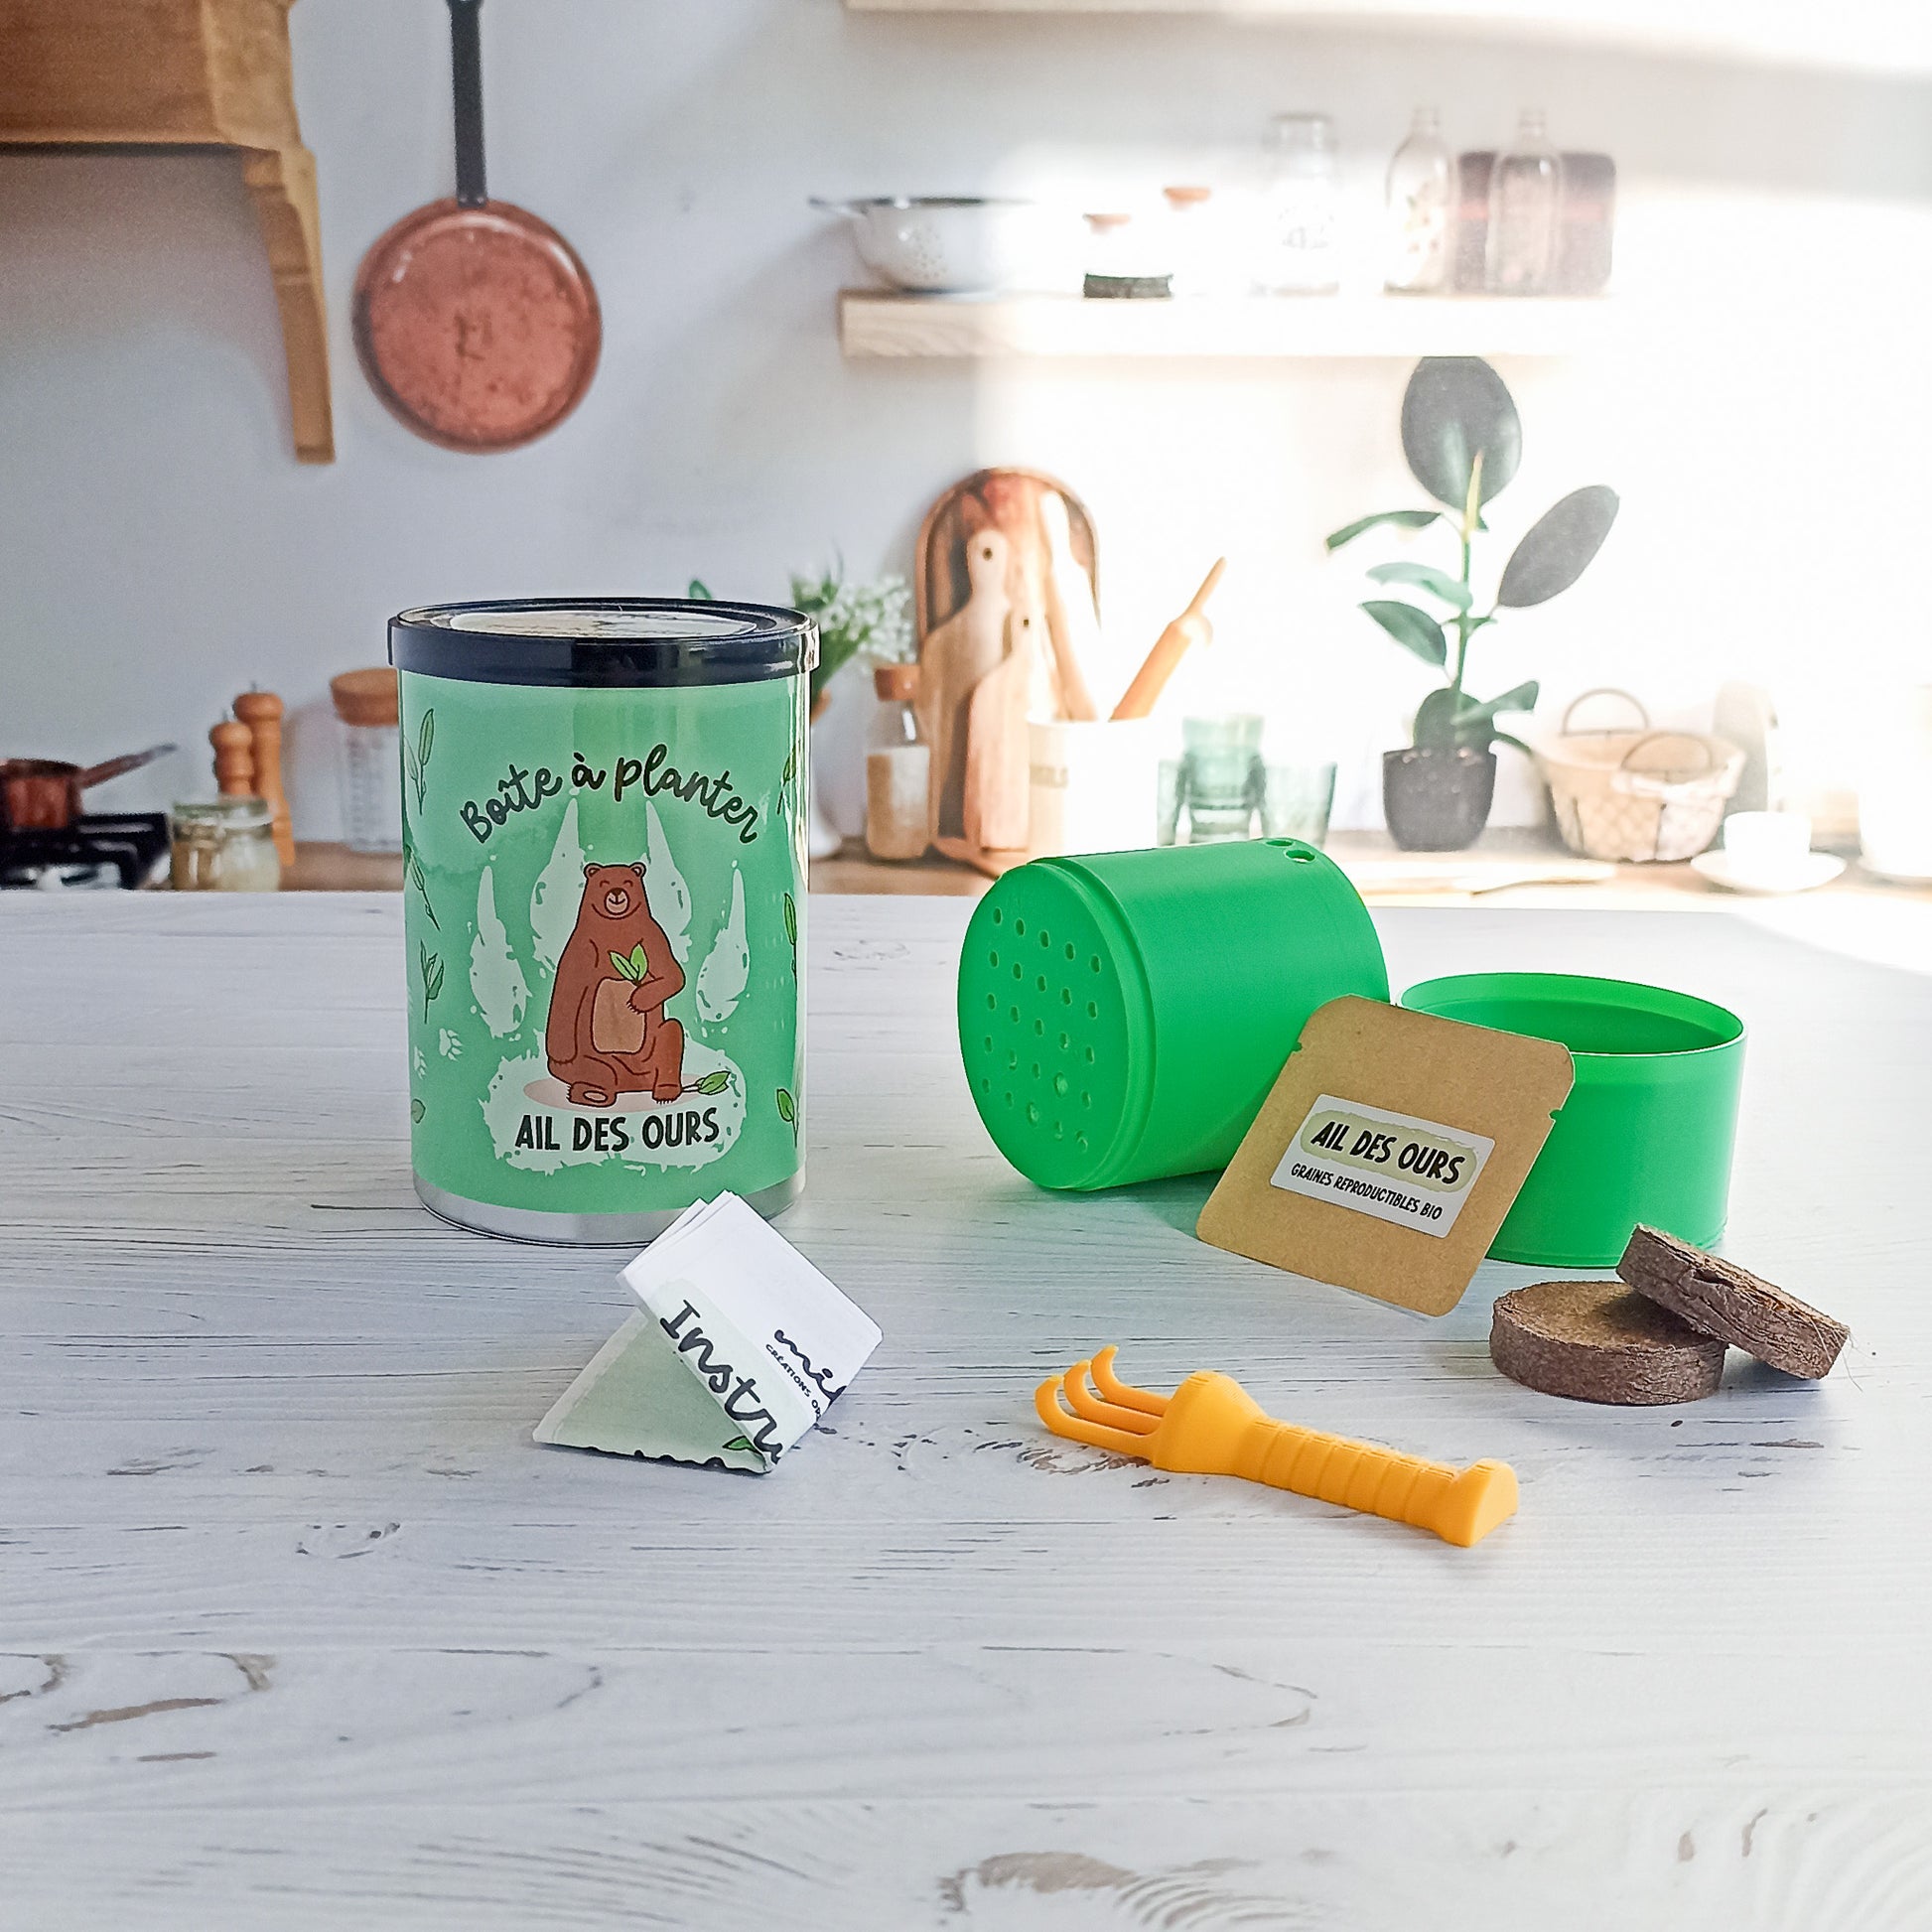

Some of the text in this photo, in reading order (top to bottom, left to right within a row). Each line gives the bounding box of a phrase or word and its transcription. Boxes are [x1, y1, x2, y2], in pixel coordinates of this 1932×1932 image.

[460, 744, 759, 844] Boîte à planter
[514, 1107, 720, 1152] AIL DES OURS
[1311, 1121, 1465, 1184] AIL DES OURS
[1291, 1163, 1444, 1220] GRAINES REPRODUCTIBLES BIO
